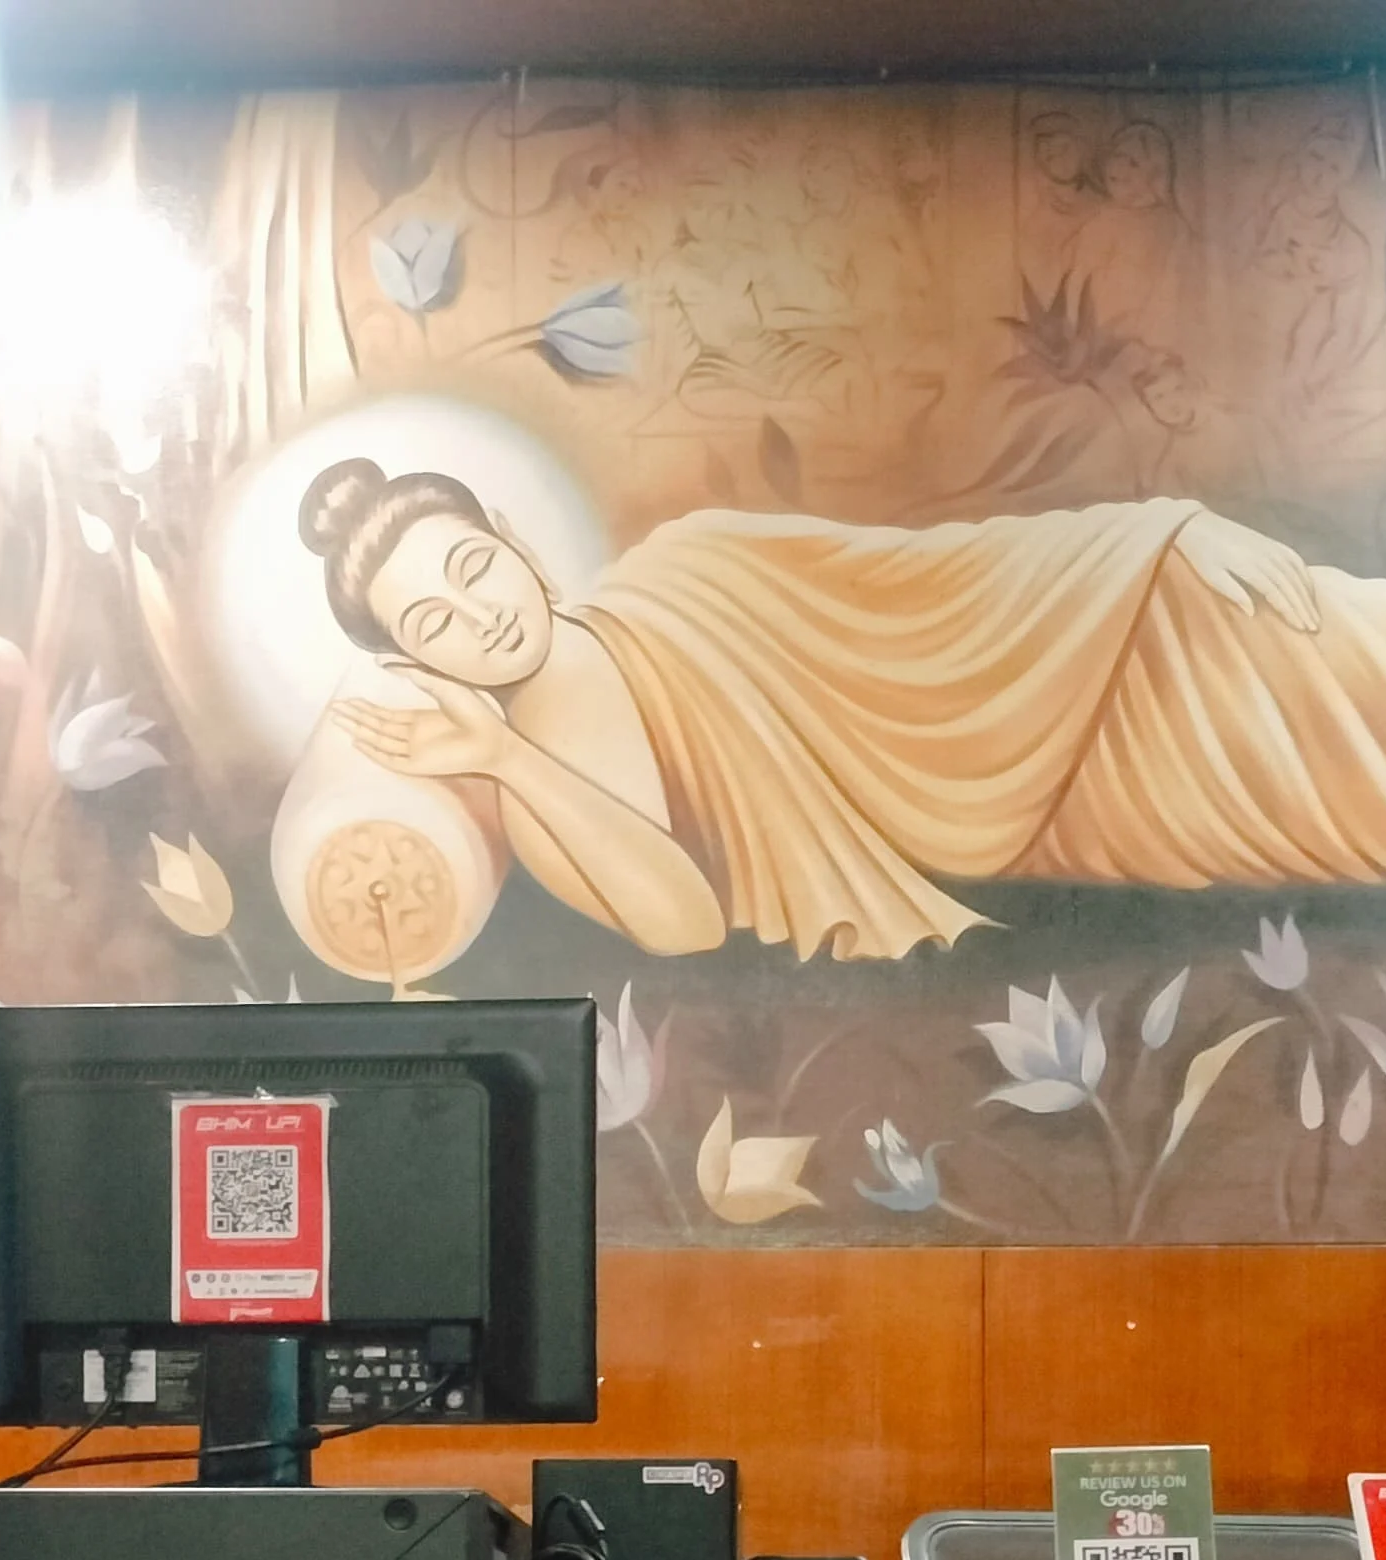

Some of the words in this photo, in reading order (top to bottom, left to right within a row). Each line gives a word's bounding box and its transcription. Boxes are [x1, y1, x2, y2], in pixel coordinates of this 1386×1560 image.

[195, 1116, 253, 1132] BHIM
[265, 1115, 302, 1129] UPI
[1079, 1476, 1137, 1490] REVIEW
[1141, 1477, 1160, 1489] US
[1164, 1475, 1187, 1488] ON
[1100, 1490, 1168, 1510] Google
